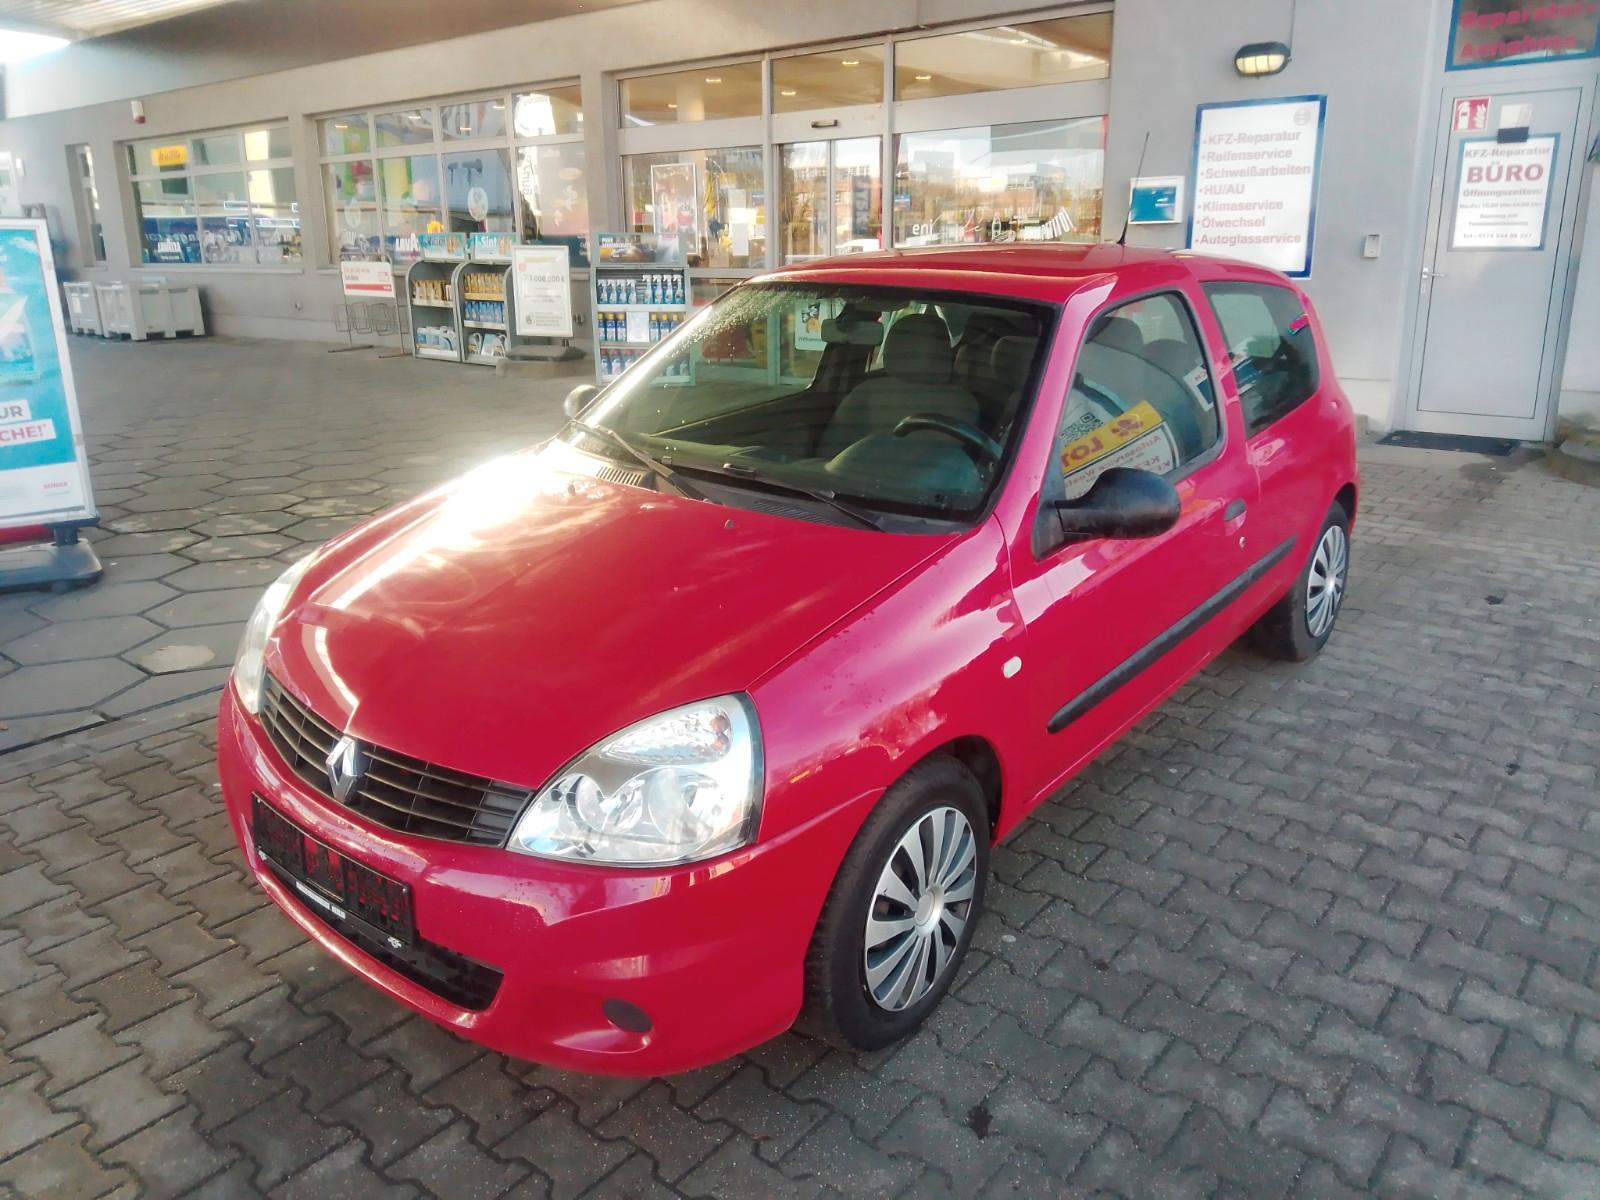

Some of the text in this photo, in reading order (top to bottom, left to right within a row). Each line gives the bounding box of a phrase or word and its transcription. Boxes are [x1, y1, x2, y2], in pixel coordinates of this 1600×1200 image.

[1461, 34, 1577, 58] Annahme
[1207, 130, 1302, 146] KFZ-Reparatur
[1206, 147, 1293, 163] Reifenservice
[1464, 146, 1551, 159] KFZ-Reparatur
[1205, 164, 1311, 180] Schweißarbeiten
[1466, 161, 1545, 184] BÜRO
[1203, 183, 1246, 196] HU/AU
[1202, 200, 1284, 213] Klimaservice
[1200, 215, 1266, 229] Ölwechsel
[1199, 234, 1302, 247] Autoglasservice
